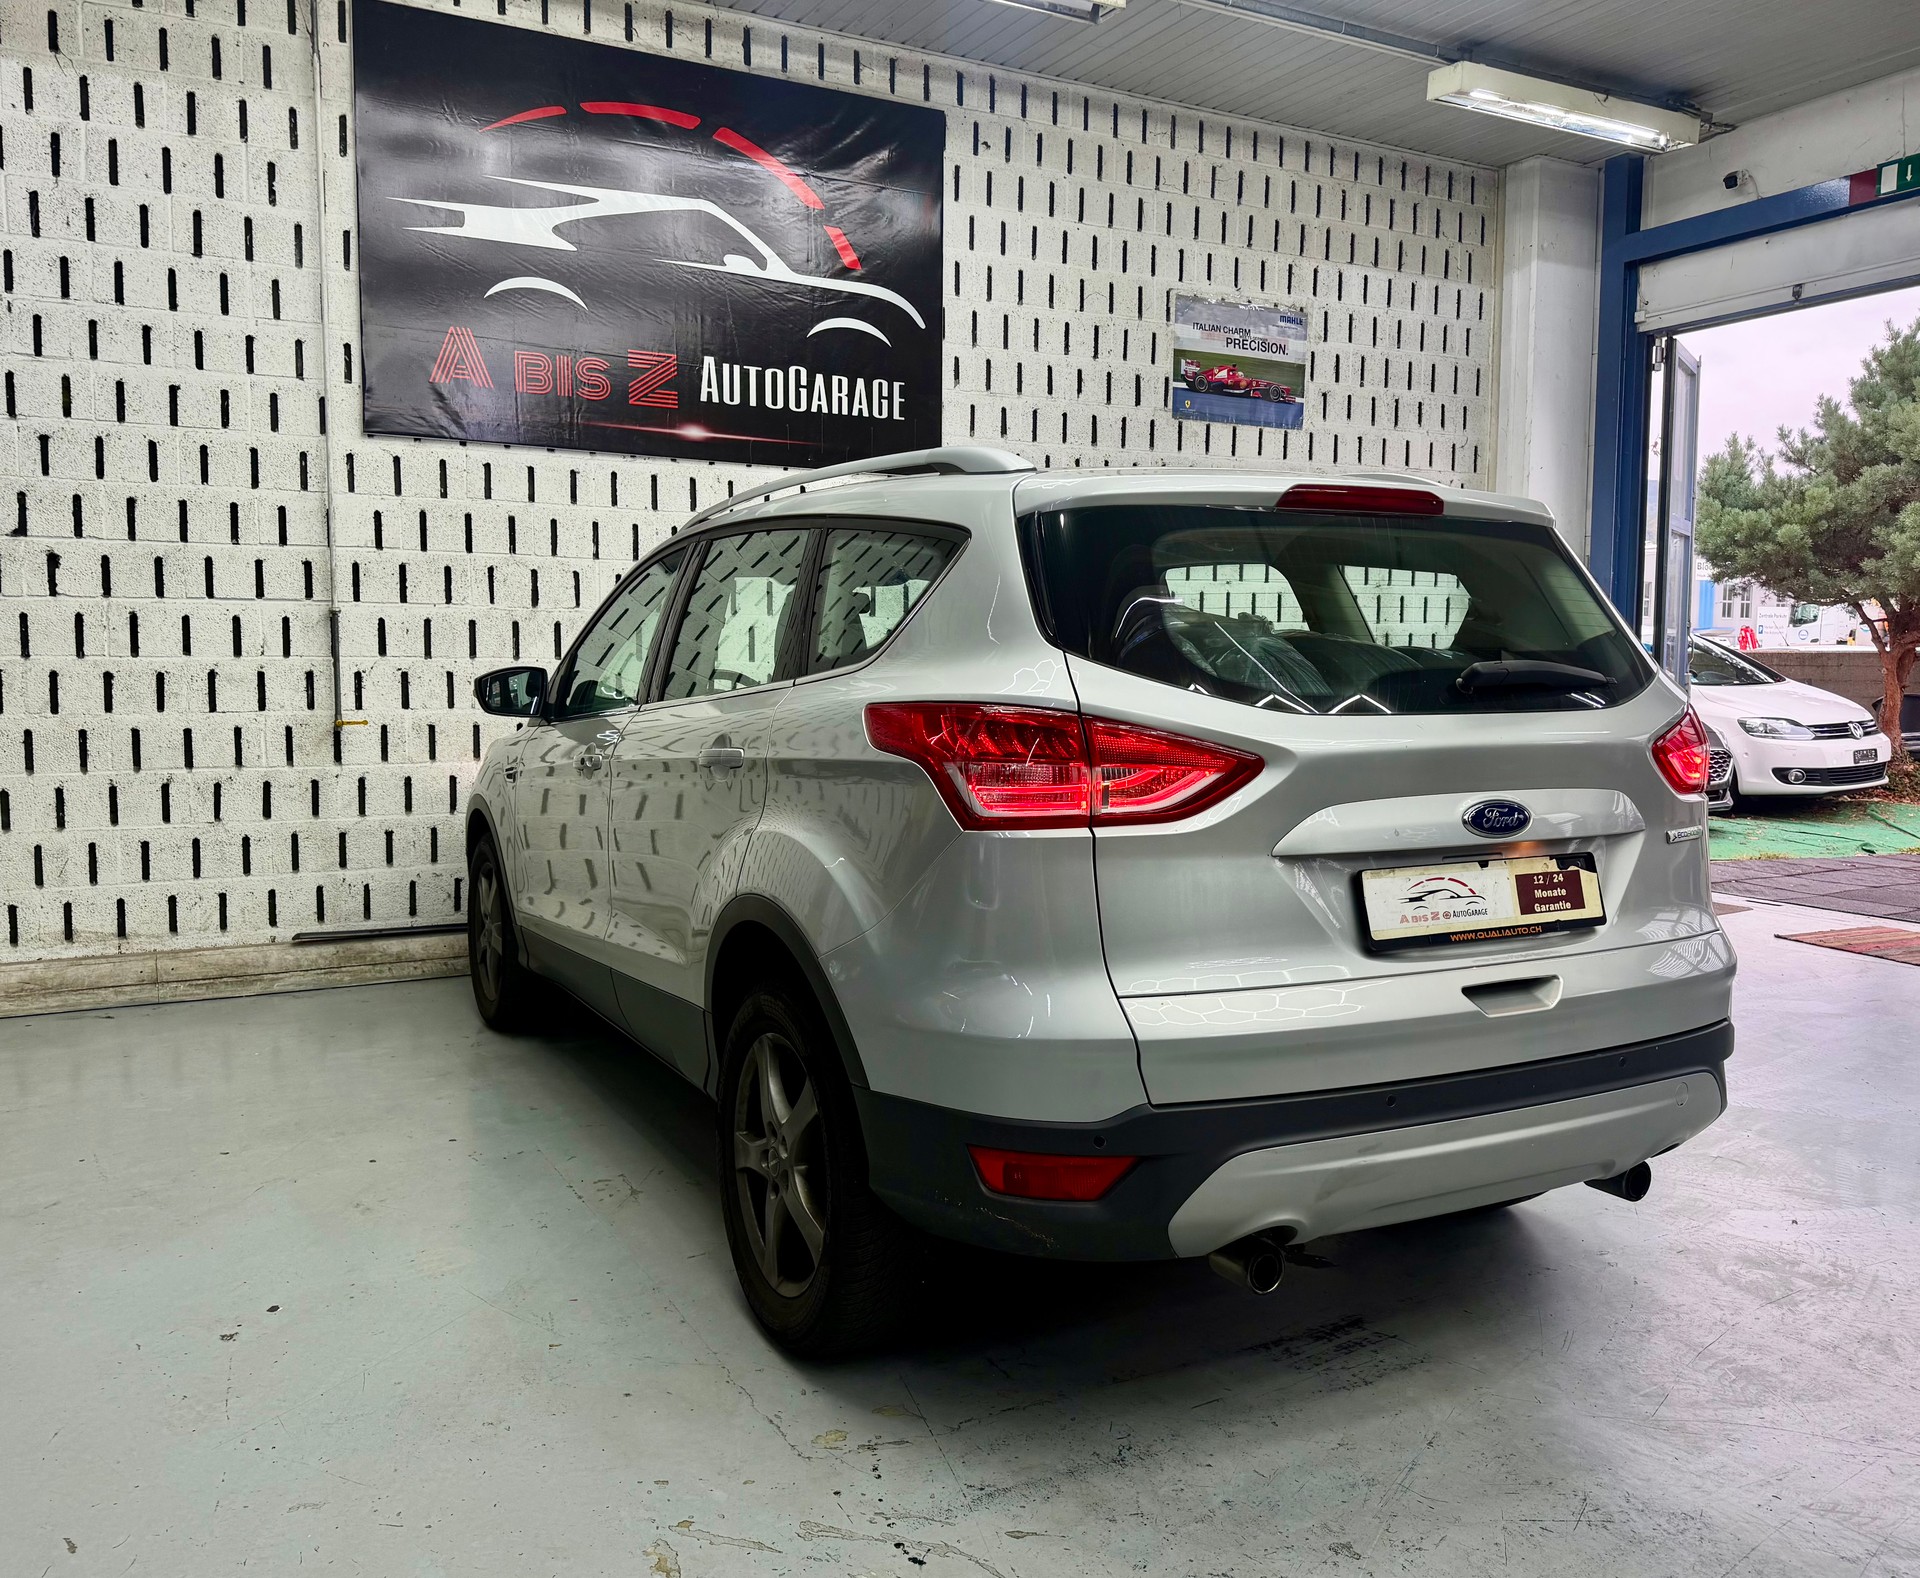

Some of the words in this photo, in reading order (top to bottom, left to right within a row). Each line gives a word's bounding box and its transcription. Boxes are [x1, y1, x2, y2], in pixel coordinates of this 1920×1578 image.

[1279, 315, 1304, 326] MAHLE
[1192, 322, 1222, 333] ITALIAN
[1222, 326, 1251, 337] CHARM
[1225, 337, 1289, 356] PRECISION.
[428, 325, 494, 388] A
[513, 350, 611, 401] BIS
[627, 349, 679, 409] Z
[1482, 807, 1524, 829] Ford
[1533, 875, 1544, 885] 12
[1553, 873, 1565, 883] 24
[1534, 887, 1567, 899] Monate
[1534, 900, 1572, 913] Garantie
[1399, 914, 1410, 924] A
[1430, 911, 1441, 921] Z
[1450, 925, 1543, 942] WWW.QUALIAUTO.CH
